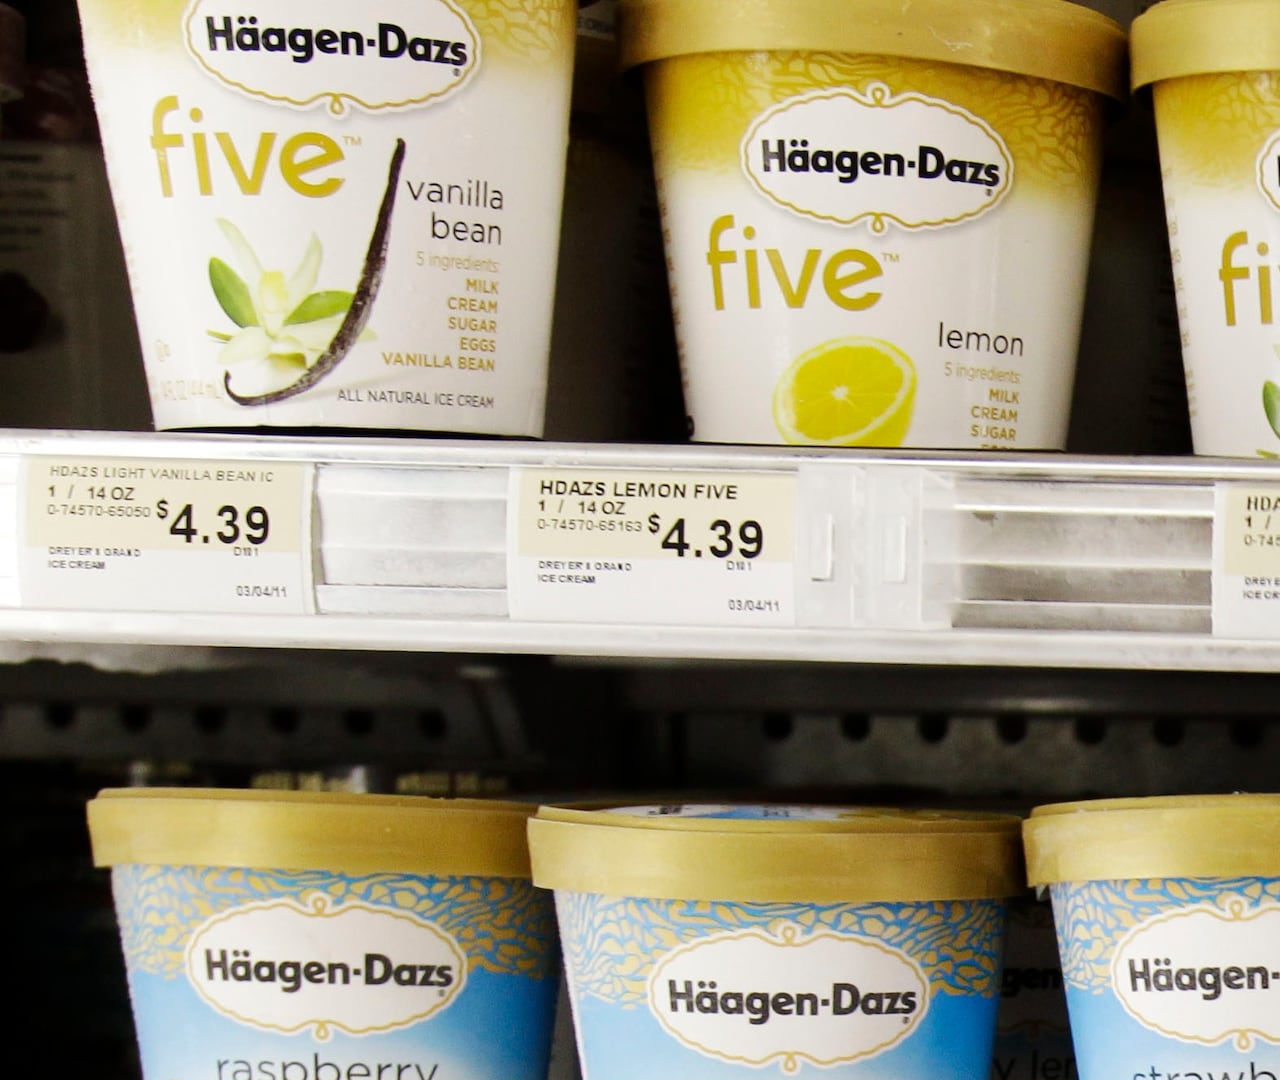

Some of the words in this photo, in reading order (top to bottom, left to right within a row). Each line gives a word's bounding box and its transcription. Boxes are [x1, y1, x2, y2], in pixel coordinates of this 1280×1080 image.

[150, 95, 346, 198] five
[406, 178, 504, 210] vanilla
[431, 212, 502, 246] bean
[707, 214, 883, 312] five
[466, 278, 499, 294] MILK
[447, 296, 498, 314] CREAM
[448, 317, 497, 334] SUGAR
[459, 337, 496, 353] EGGS
[939, 322, 1023, 357] lemon
[382, 352, 453, 369] VANILLA
[458, 355, 495, 371] BEAN
[337, 389, 363, 402] ALL
[368, 390, 430, 405] NATURAL
[434, 392, 454, 407] ICE
[457, 394, 494, 409] CREAM
[50, 466, 98, 478] HDAZS
[104, 467, 145, 479] LIGHT
[150, 468, 211, 481] VANILLA
[217, 470, 256, 482] BEAN
[261, 471, 274, 482] IC
[540, 480, 605, 496] HDAZS
[613, 481, 686, 498] LEMON
[694, 484, 738, 500] FIVE
[578, 501, 597, 515] 14
[602, 501, 626, 515] OZ
[156, 499, 270, 545] $4.39
[648, 513, 763, 559] $4.39
